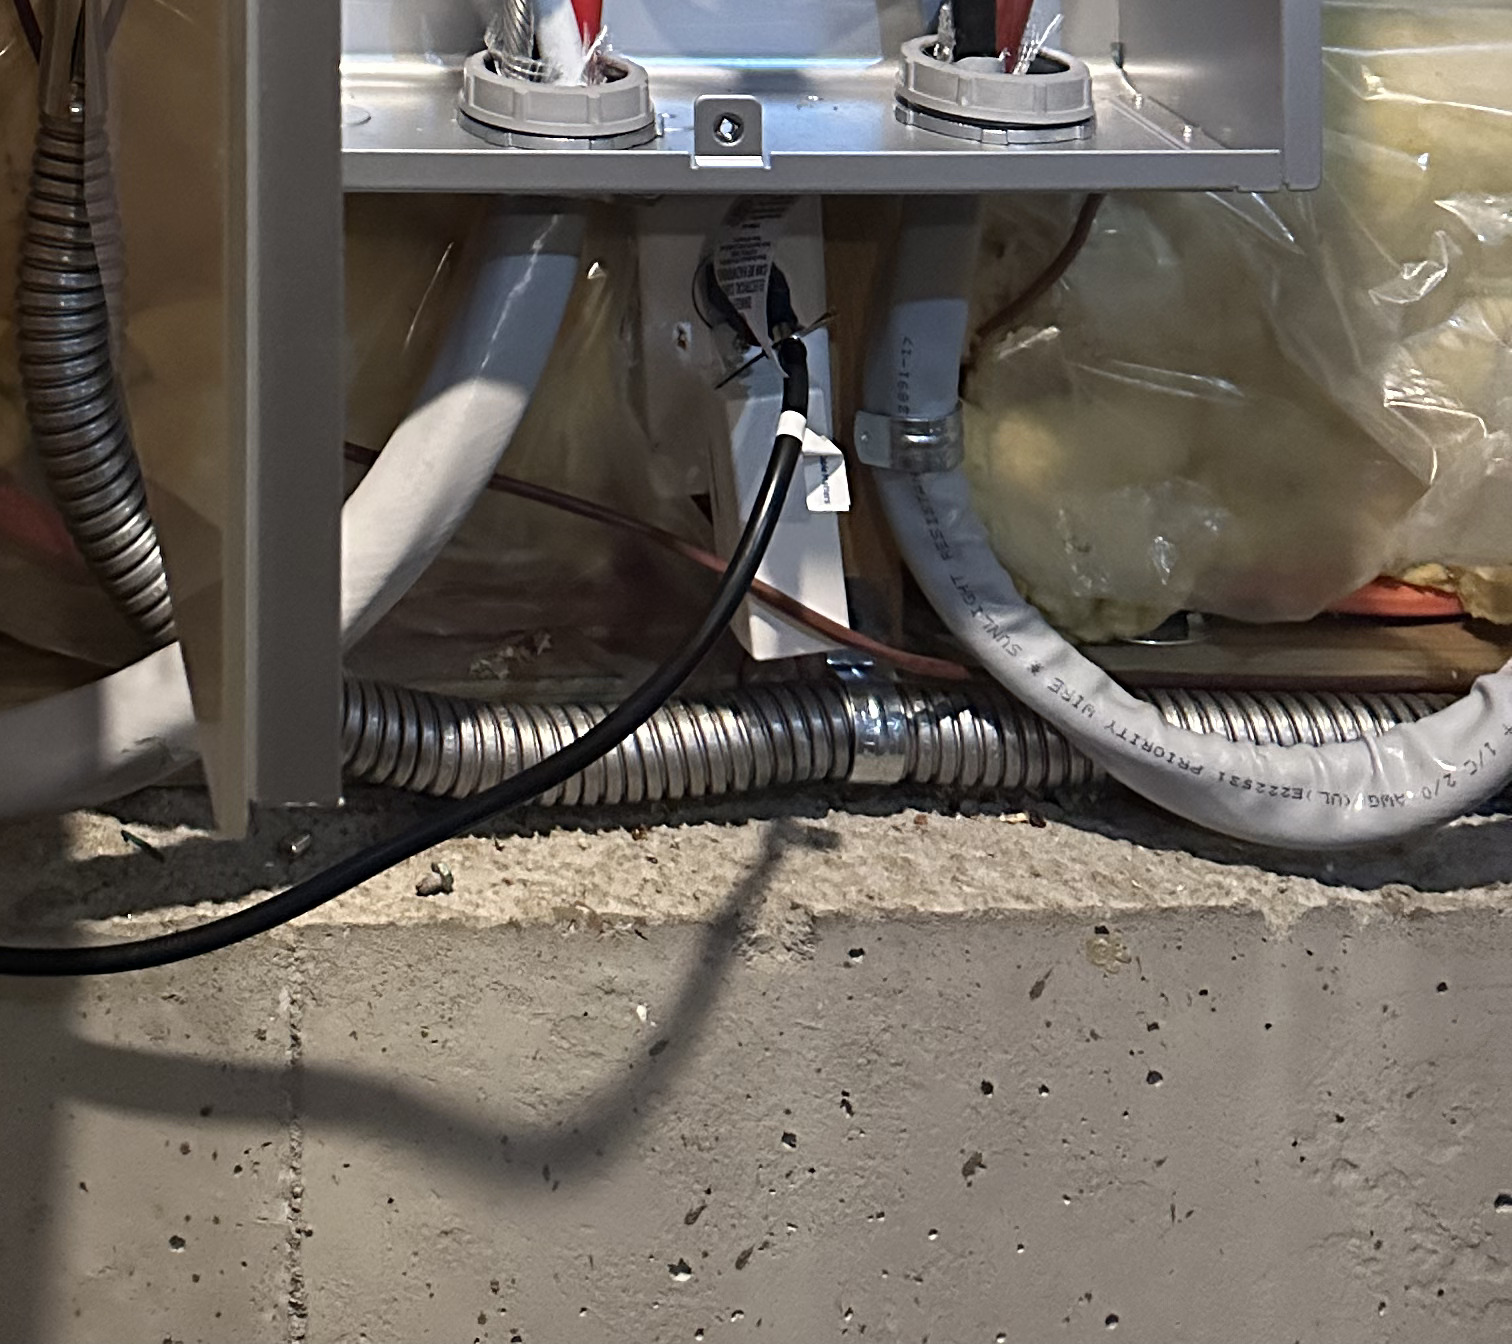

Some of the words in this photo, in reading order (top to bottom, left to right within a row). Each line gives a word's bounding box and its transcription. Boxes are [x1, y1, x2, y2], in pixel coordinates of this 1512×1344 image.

[950, 572, 1024, 658] SUNLIGHT
[1045, 676, 1097, 718] WIRE
[1103, 718, 1205, 776] PRIORITY
[1463, 741, 1497, 776] 1/C
[1367, 791, 1408, 810] AWG
[1421, 772, 1457, 800] 2/0
